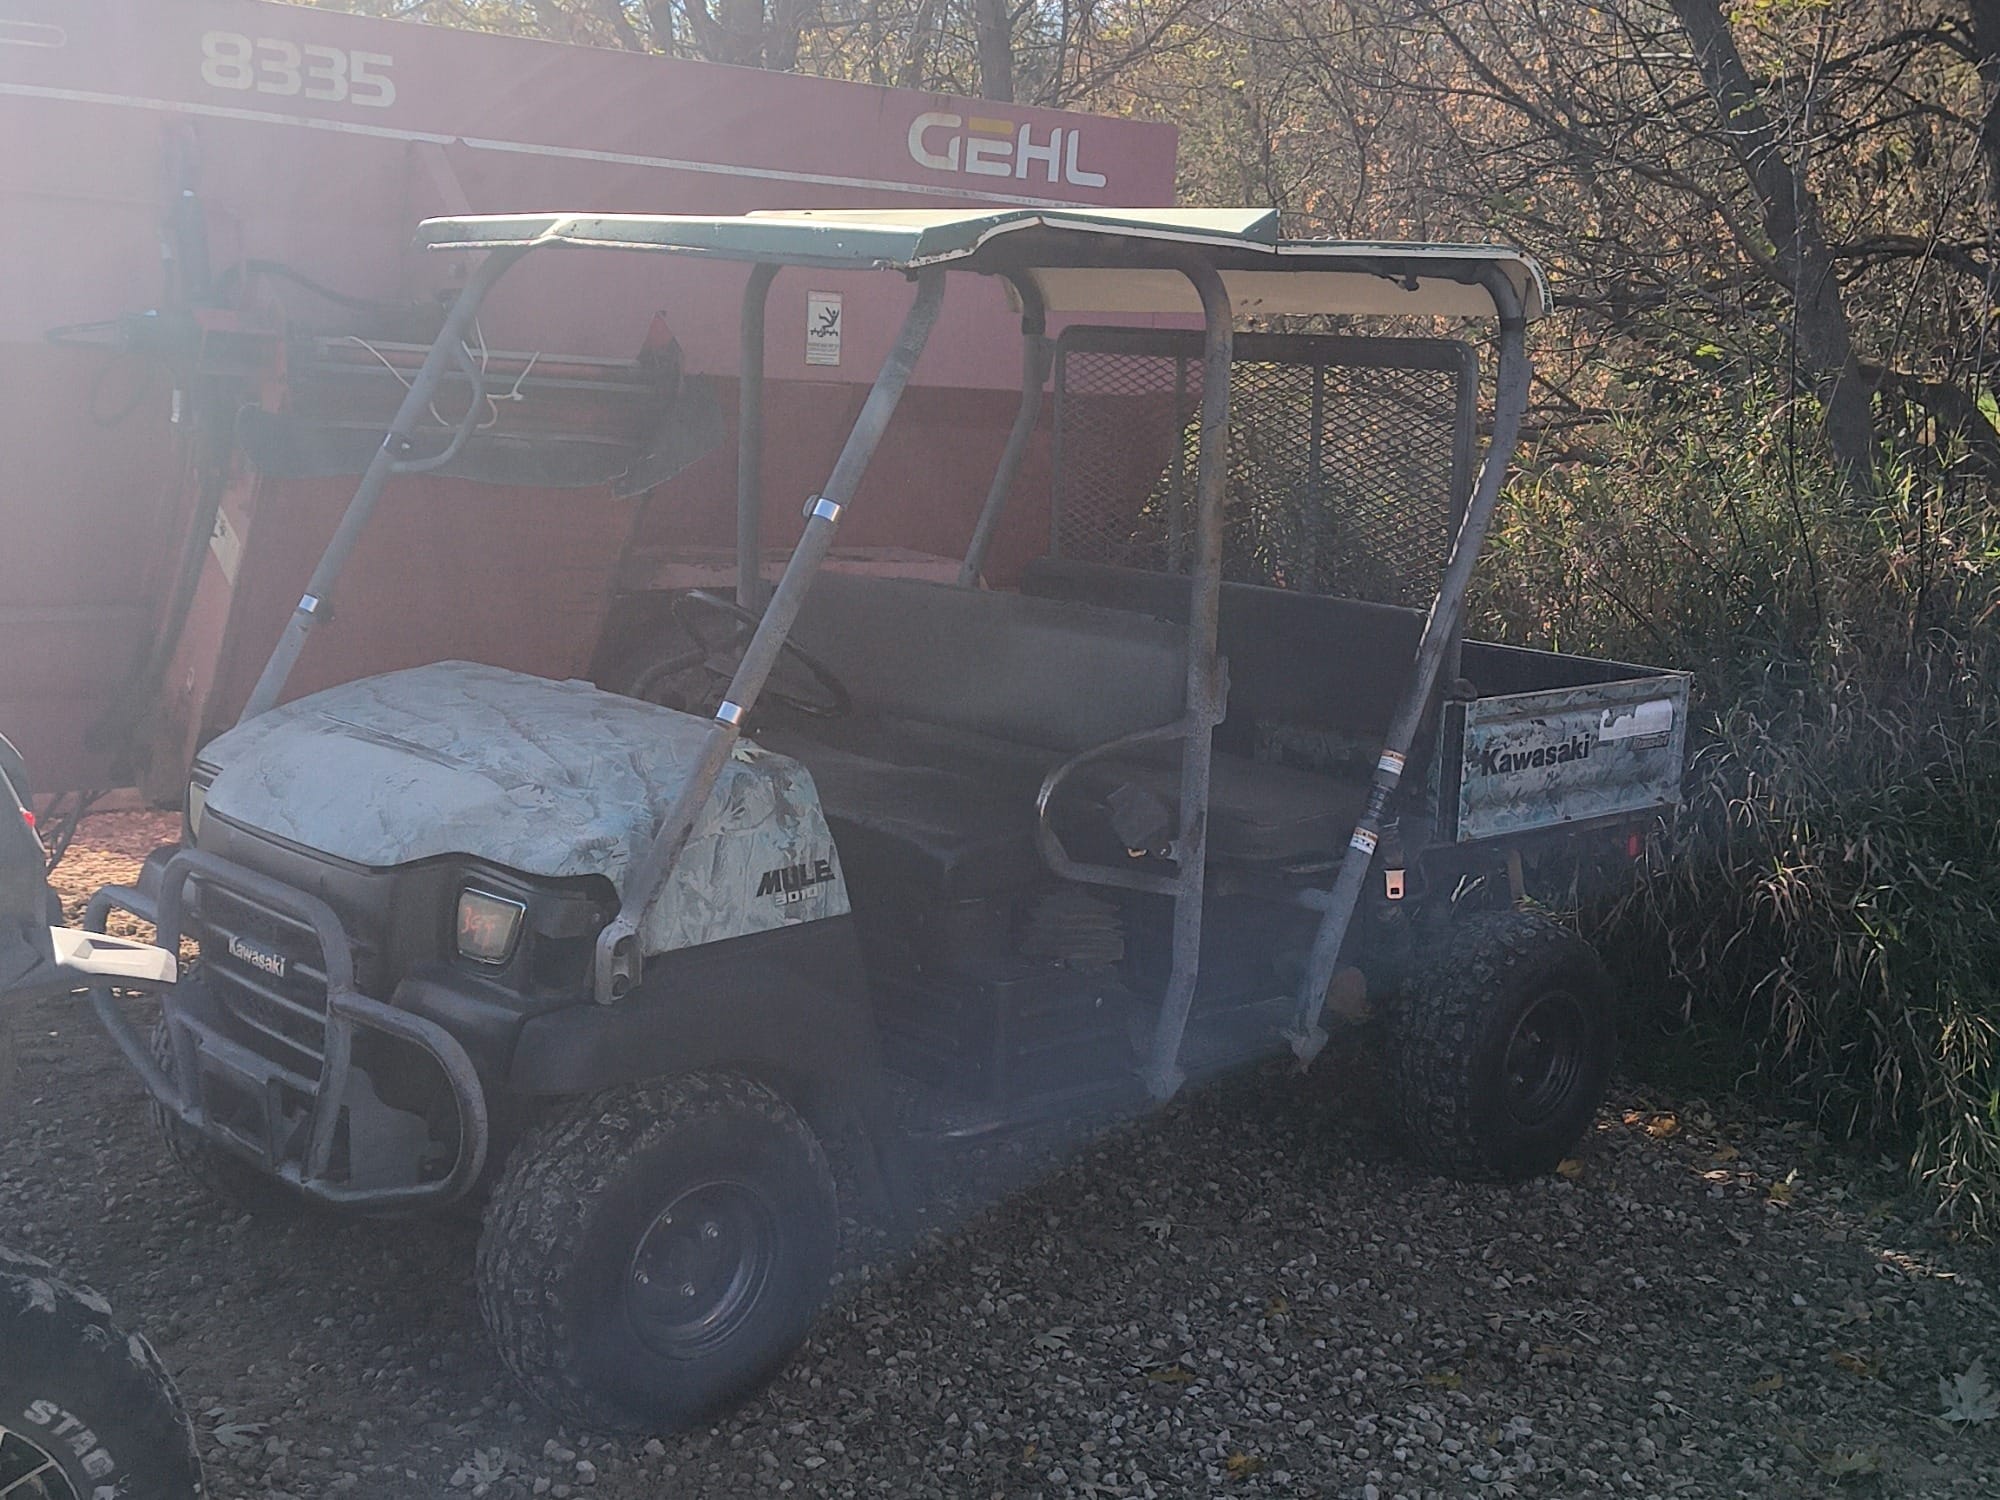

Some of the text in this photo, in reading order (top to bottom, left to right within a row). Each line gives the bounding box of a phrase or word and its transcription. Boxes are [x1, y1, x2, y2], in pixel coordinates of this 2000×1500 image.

[201, 29, 396, 107] 8335
[908, 112, 1107, 187] GEHL
[1481, 733, 1590, 776] Kawasaki
[756, 859, 836, 897] MULE
[228, 936, 286, 977] Kawasaki
[24, 1399, 115, 1479] STAG
